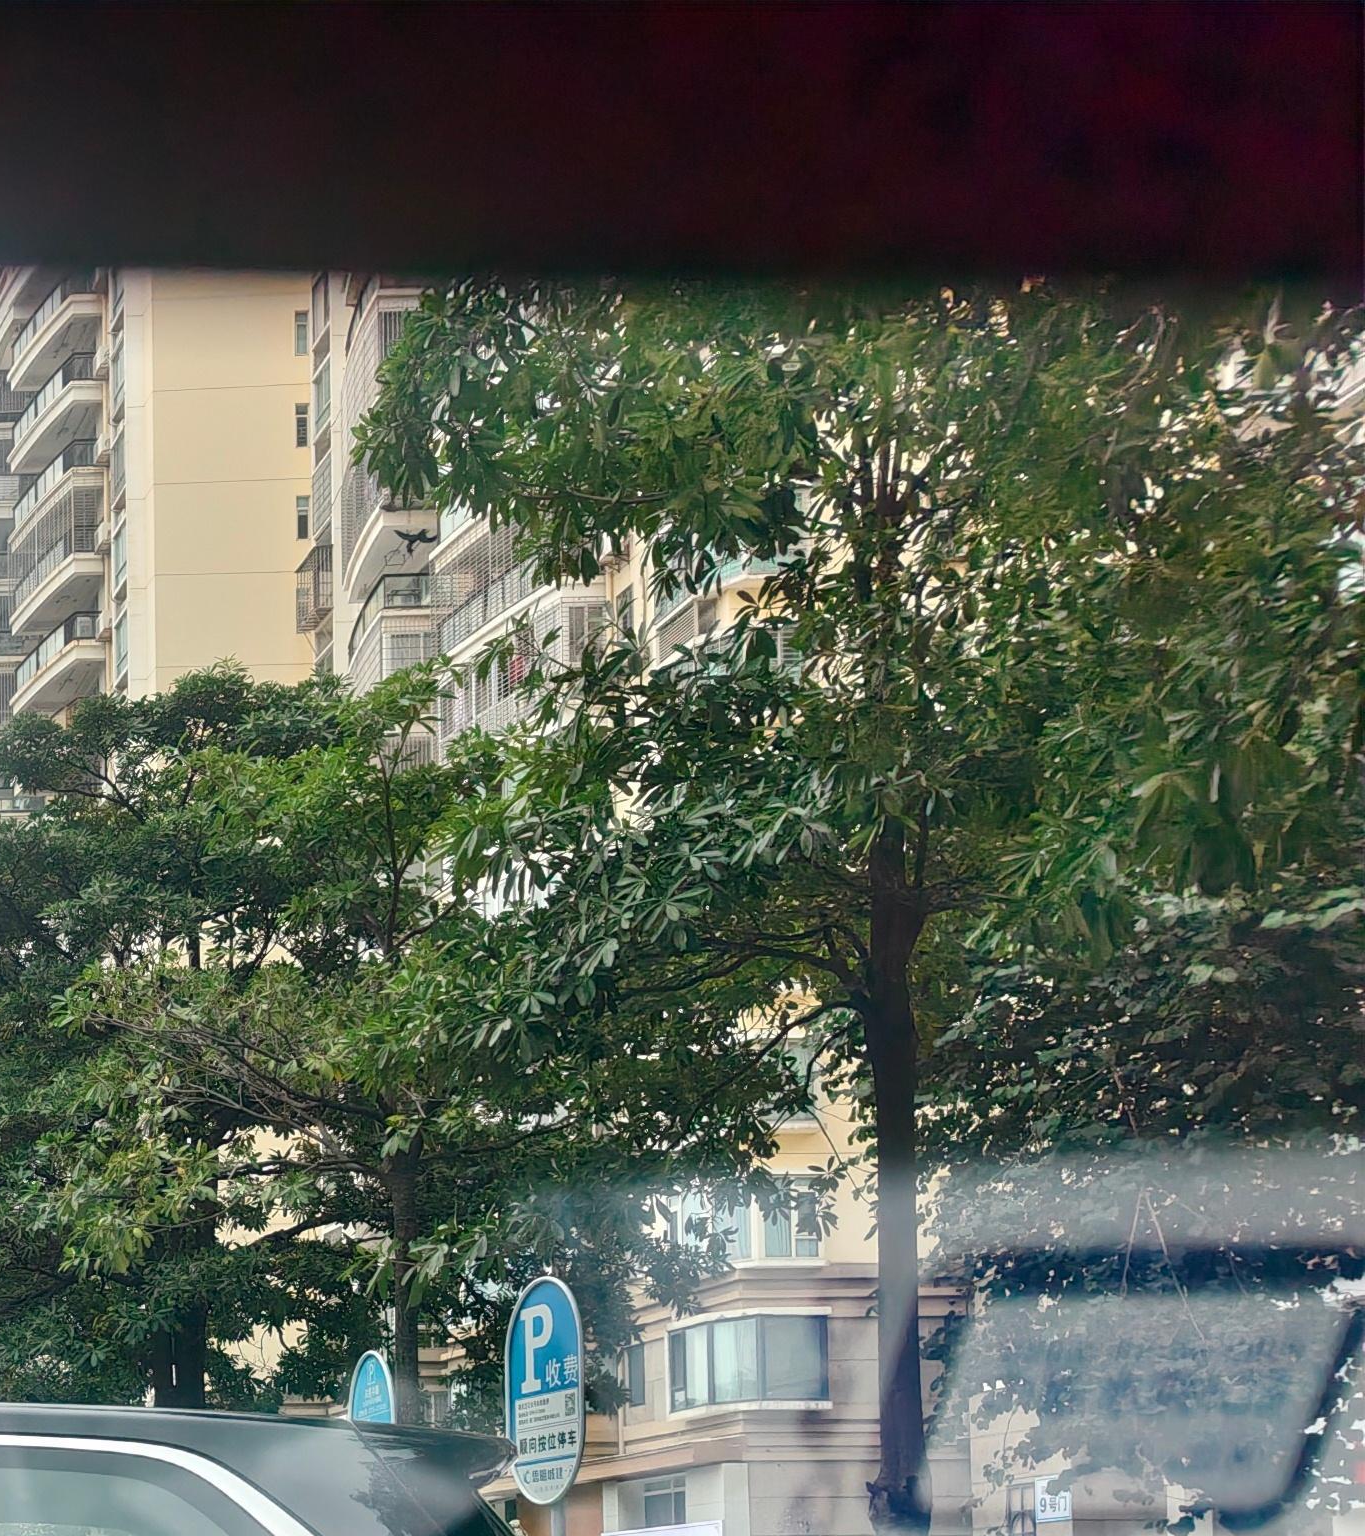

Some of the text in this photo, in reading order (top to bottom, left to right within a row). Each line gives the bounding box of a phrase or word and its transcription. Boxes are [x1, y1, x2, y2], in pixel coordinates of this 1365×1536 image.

[519, 1303, 554, 1394] P
[545, 1353, 578, 1388] 收费
[519, 1429, 577, 1455] 顺向按位停车
[1039, 1496, 1067, 1513] 9号门
